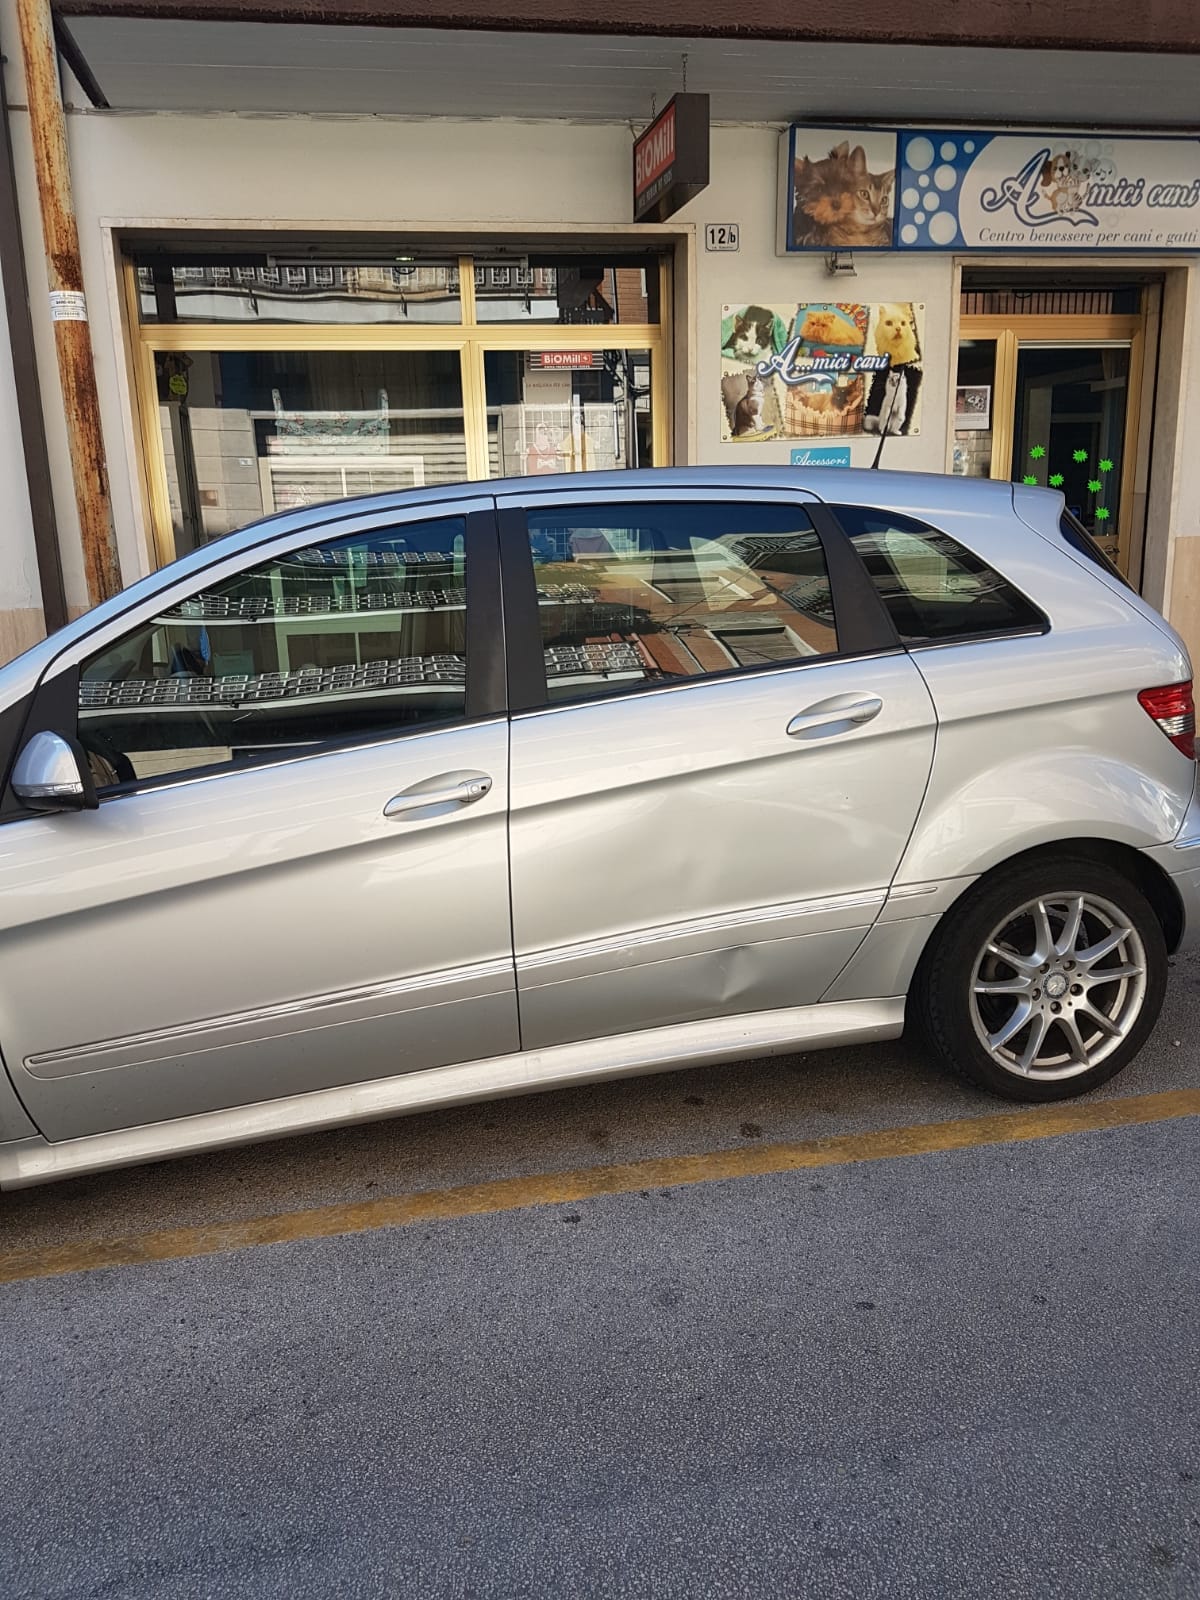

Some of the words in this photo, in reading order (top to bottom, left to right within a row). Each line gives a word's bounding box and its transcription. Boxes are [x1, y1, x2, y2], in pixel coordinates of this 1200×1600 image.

[1147, 178, 1200, 208] cani
[979, 228, 1025, 242] Centro
[1029, 228, 1094, 242] benessere
[1095, 232, 1121, 246] per
[1123, 229, 1152, 242] cani
[1155, 233, 1163, 242] e
[1165, 229, 1199, 245] gatti
[853, 352, 890, 370] cani
[793, 450, 849, 466] Accessori
